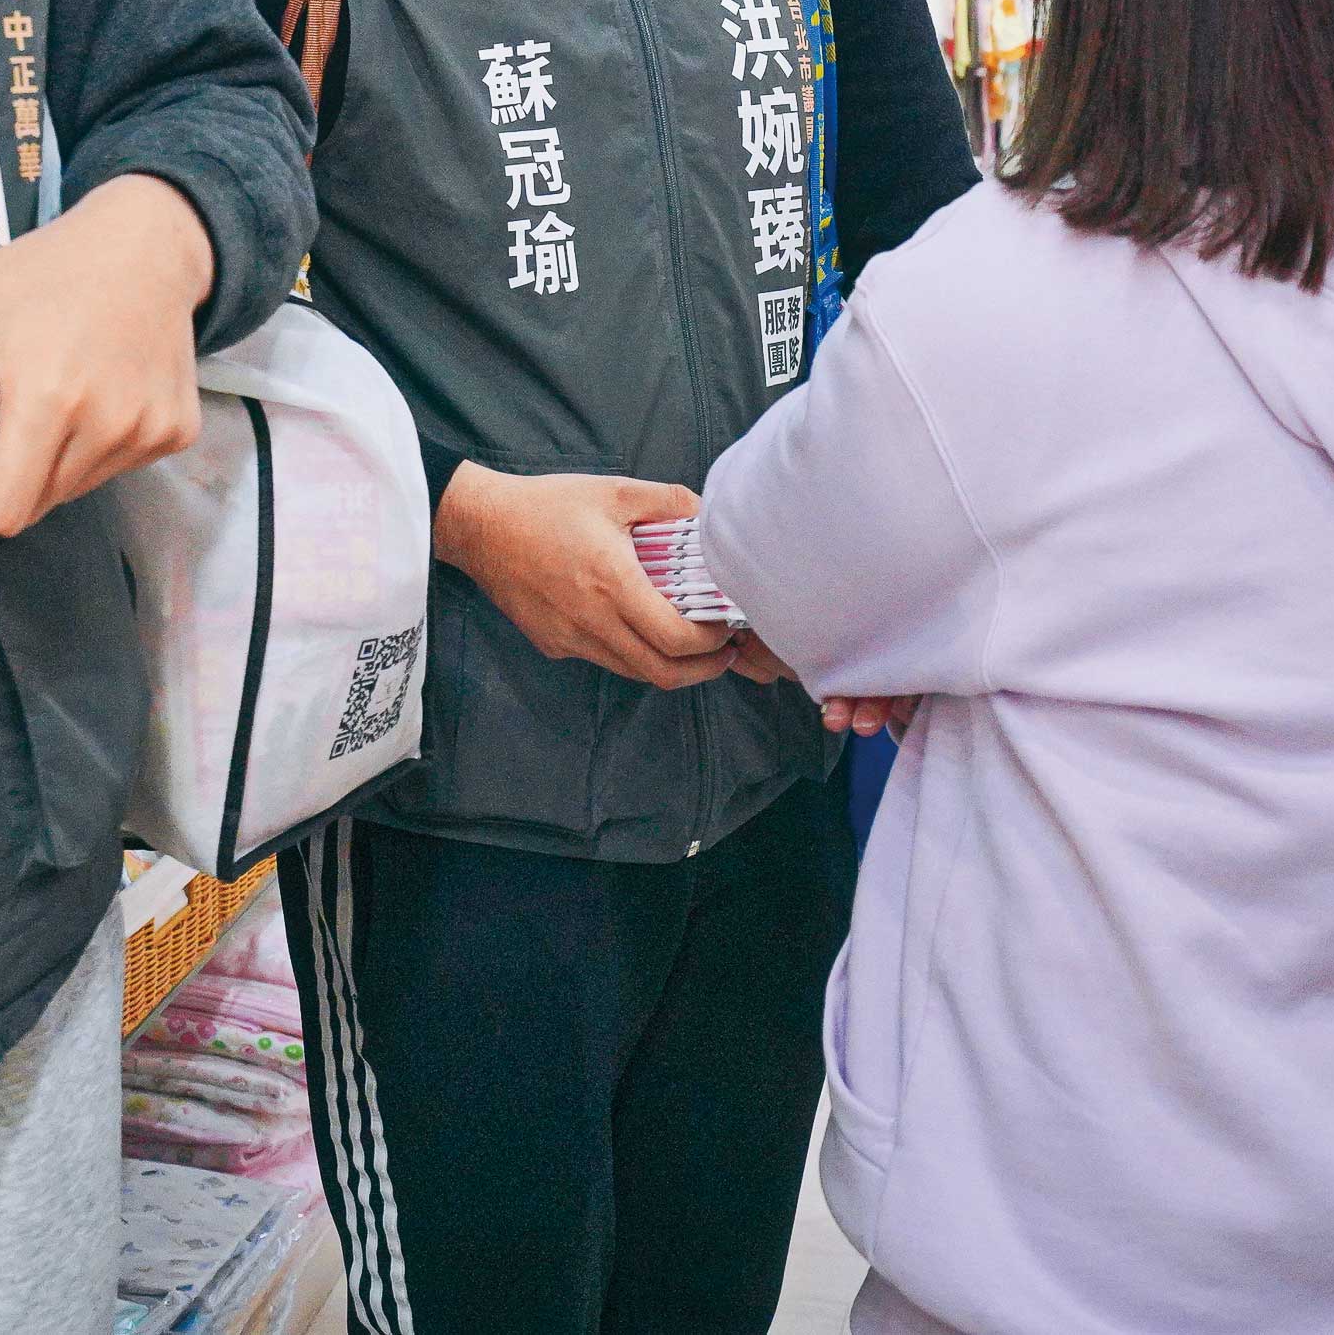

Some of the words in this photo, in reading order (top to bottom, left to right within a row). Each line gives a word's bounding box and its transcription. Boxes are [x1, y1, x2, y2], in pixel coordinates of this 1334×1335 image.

[3, 10, 43, 183] 中正萬華
[478, 38, 580, 297] 蘇冠瑜
[763, 294, 802, 336] 服務
[766, 337, 800, 379] 團隊
